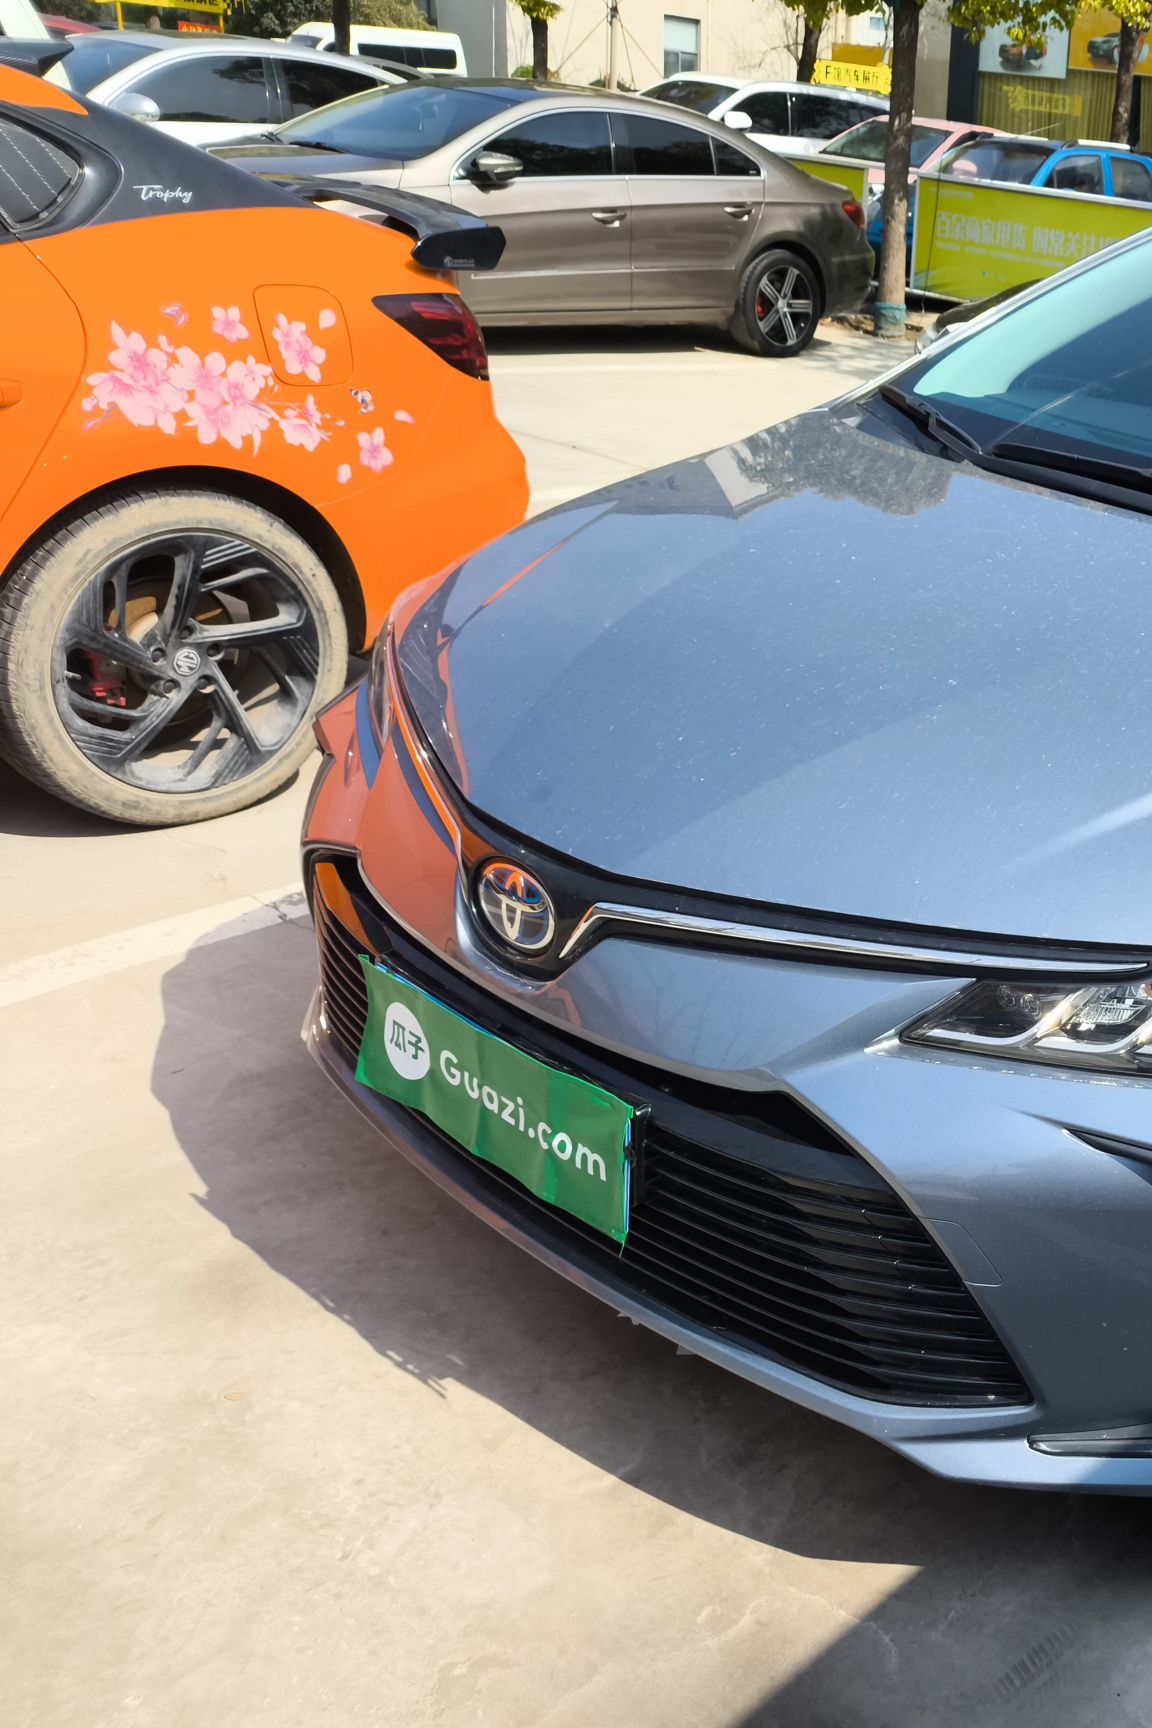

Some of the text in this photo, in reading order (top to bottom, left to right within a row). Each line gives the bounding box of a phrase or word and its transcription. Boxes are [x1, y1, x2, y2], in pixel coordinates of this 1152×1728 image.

[132, 185, 193, 203] Trophy
[390, 1018, 426, 1061] 瓜子
[440, 1049, 607, 1182] Guazi.com
